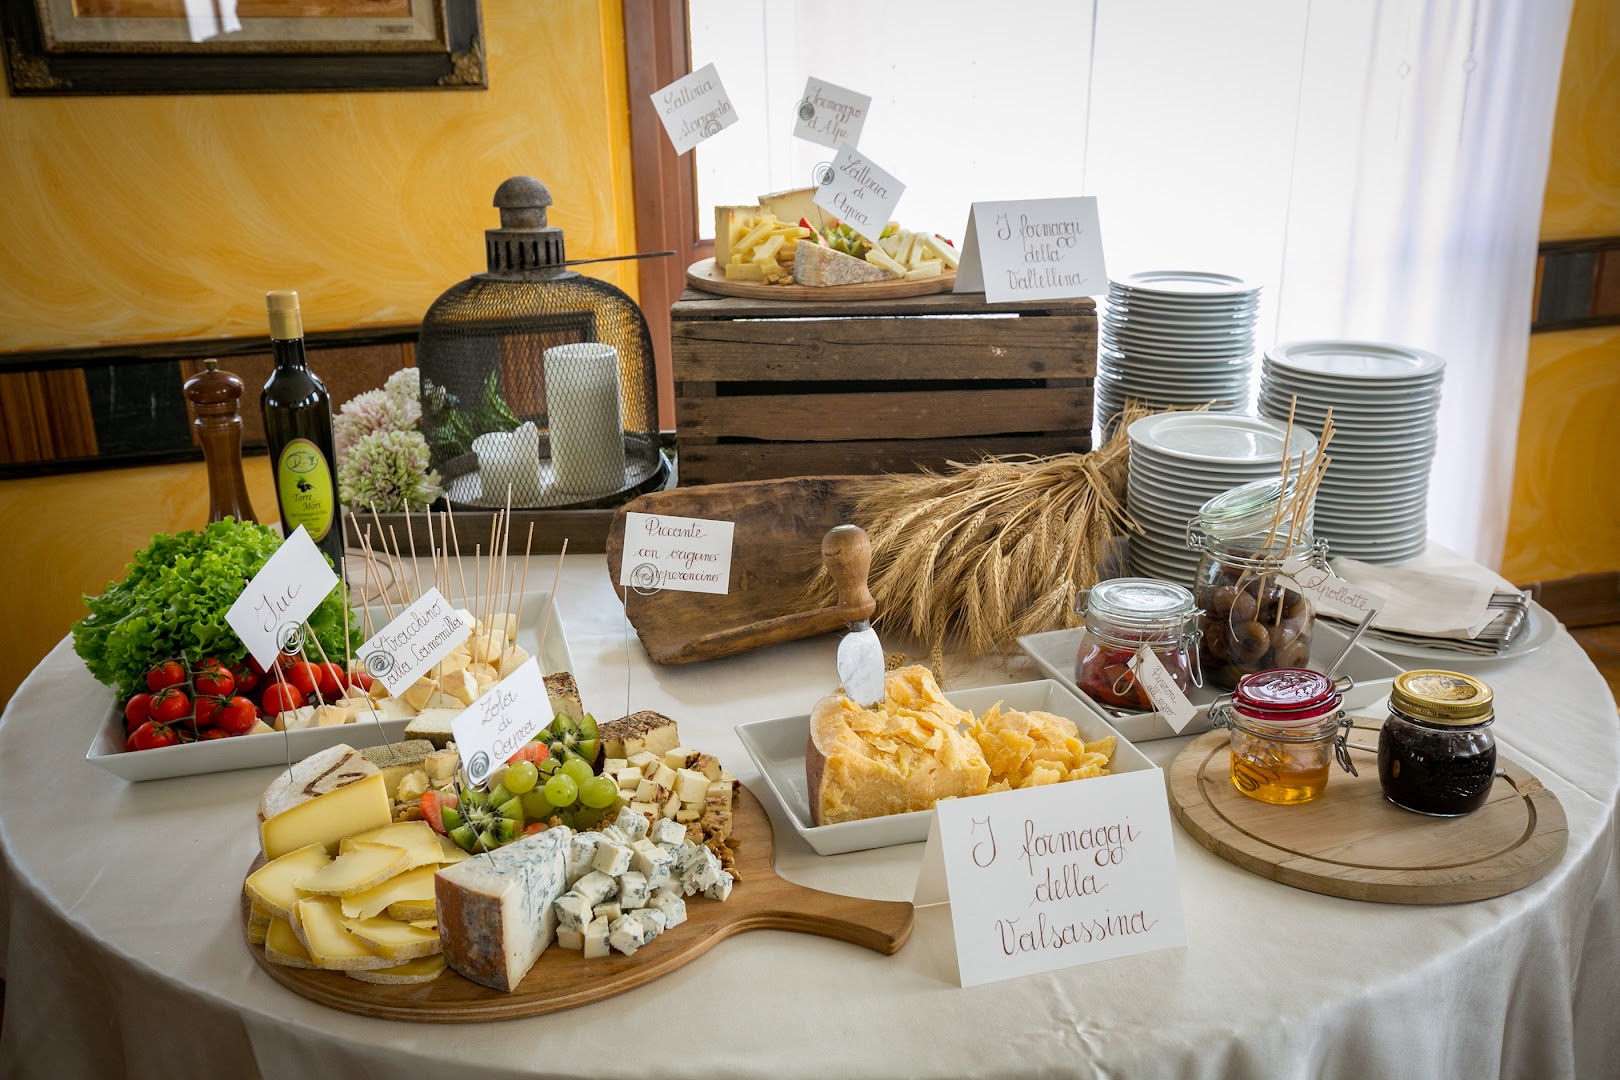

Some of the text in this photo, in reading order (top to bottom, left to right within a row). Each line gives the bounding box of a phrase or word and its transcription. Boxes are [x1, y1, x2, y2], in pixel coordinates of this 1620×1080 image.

[664, 80, 716, 114] Latteria
[806, 86, 863, 124] Formaggio
[839, 154, 888, 199] Latteria
[851, 187, 865, 200] di
[828, 192, 872, 226] Capra
[1017, 214, 1084, 251] formaggi
[1020, 243, 1066, 267] della
[1007, 267, 1089, 290] Valtellina
[292, 494, 312, 502] Torre
[645, 517, 708, 538] Piccante
[633, 547, 721, 570] con origano
[373, 598, 442, 657] Stracchino
[388, 615, 464, 689] alla Camomilla
[1152, 666, 1177, 704] Peperoni
[480, 689, 518, 726] Zola
[498, 713, 513, 734] di
[491, 719, 537, 763] Capra
[1019, 815, 1142, 876] formaggi
[1028, 863, 1109, 908] della
[994, 909, 1159, 956] Valsassina
